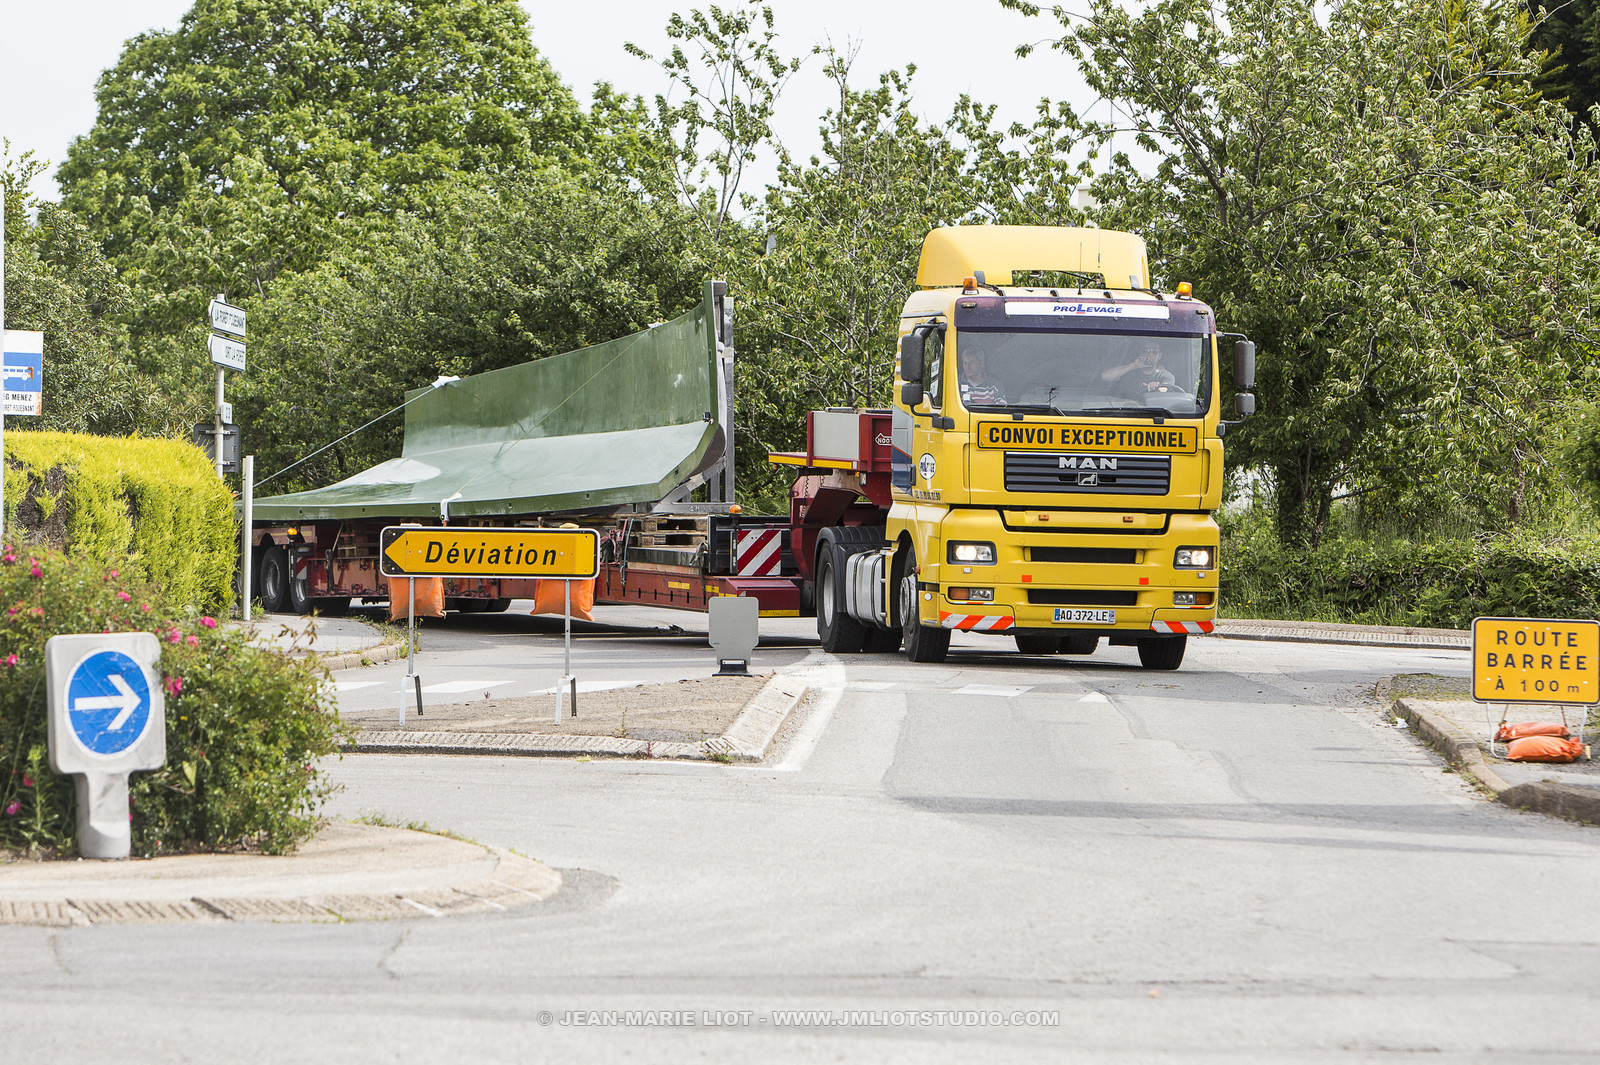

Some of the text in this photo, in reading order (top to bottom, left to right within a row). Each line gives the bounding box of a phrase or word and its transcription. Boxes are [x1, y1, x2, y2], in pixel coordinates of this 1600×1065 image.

[989, 427, 1187, 448] CONVOI EXCEPTIONNEL
[1058, 456, 1118, 470] MAN
[425, 541, 557, 566] Déviation
[1496, 630, 1578, 647] ROUTE
[1487, 651, 1587, 670] BARRÉE
[1495, 675, 1580, 693] À 100 m
